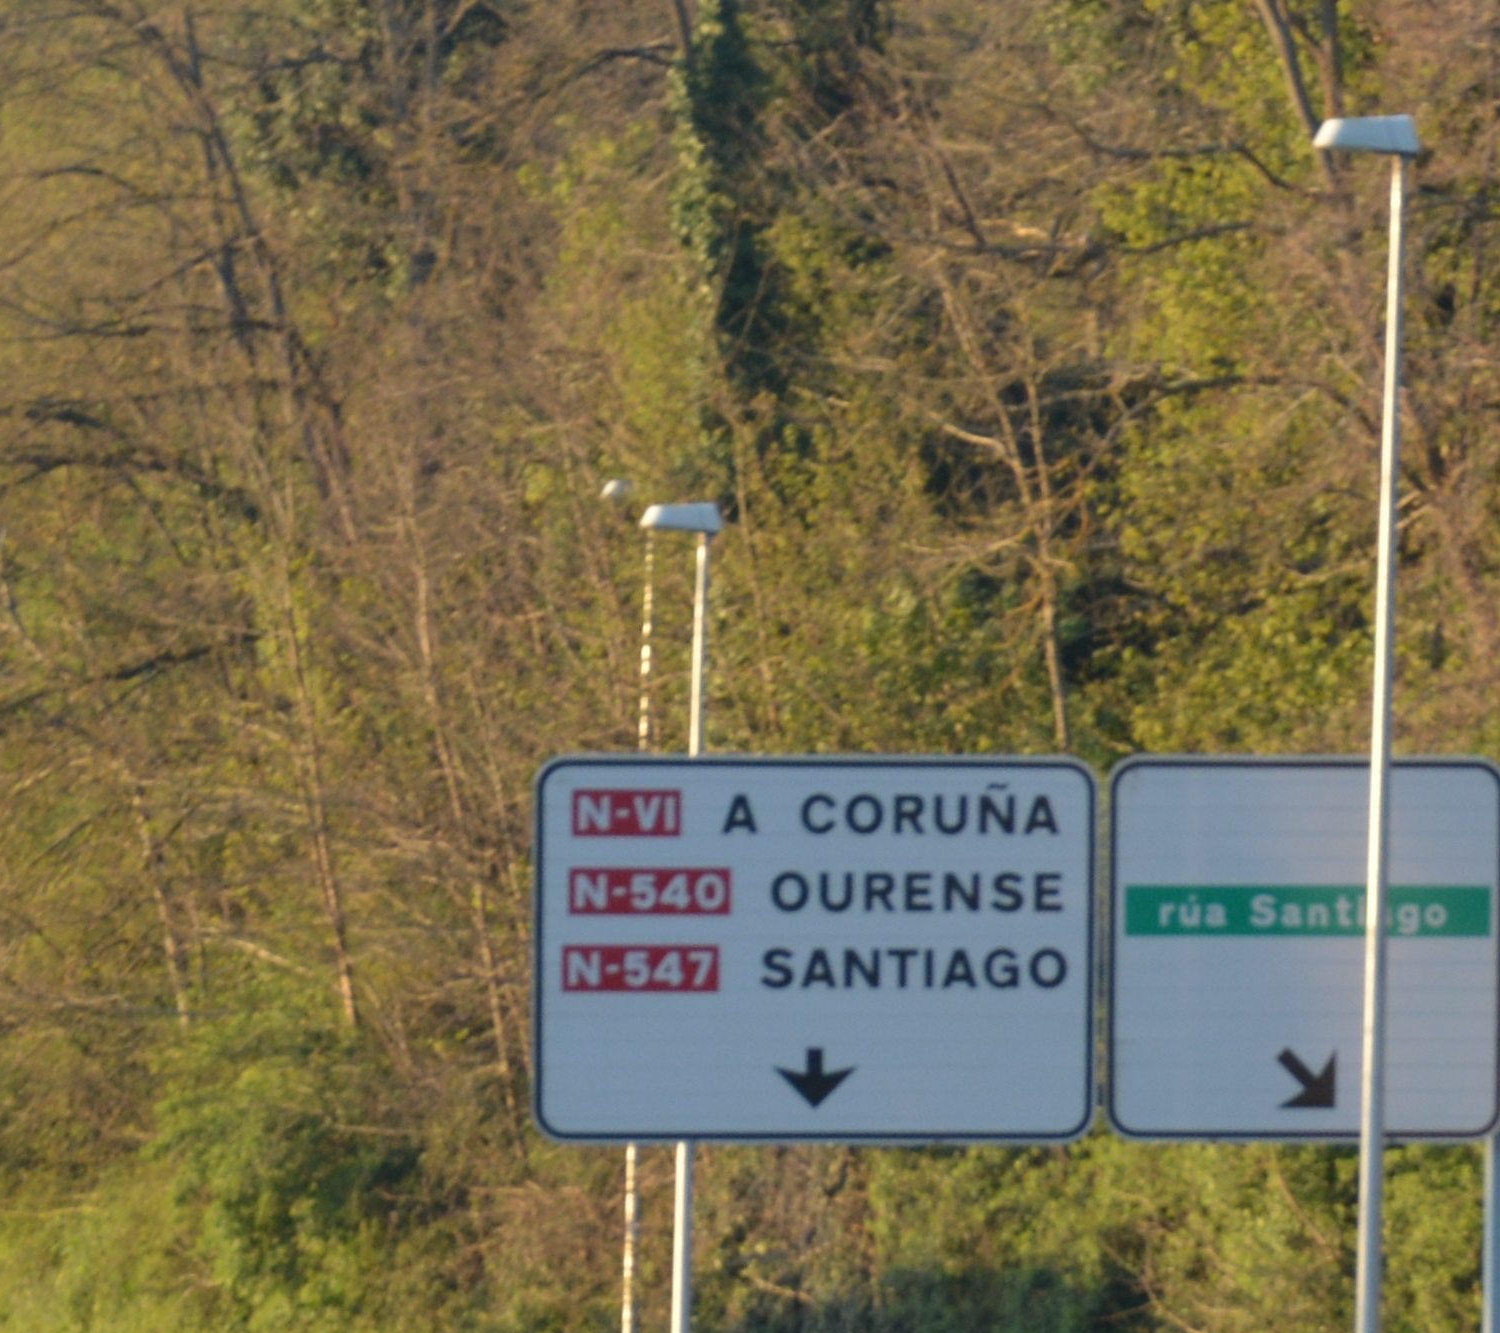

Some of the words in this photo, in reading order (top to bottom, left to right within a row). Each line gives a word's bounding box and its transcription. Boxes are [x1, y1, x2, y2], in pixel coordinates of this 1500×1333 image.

[577, 793, 676, 831] N-VI
[722, 795, 758, 834] A
[800, 784, 1059, 835] CORUÑA
[572, 875, 727, 910] N-540
[770, 872, 1064, 914] OURENSE
[1159, 894, 1227, 928] rúa
[566, 953, 713, 988] N-547
[760, 948, 1069, 989] SANTIAGO
